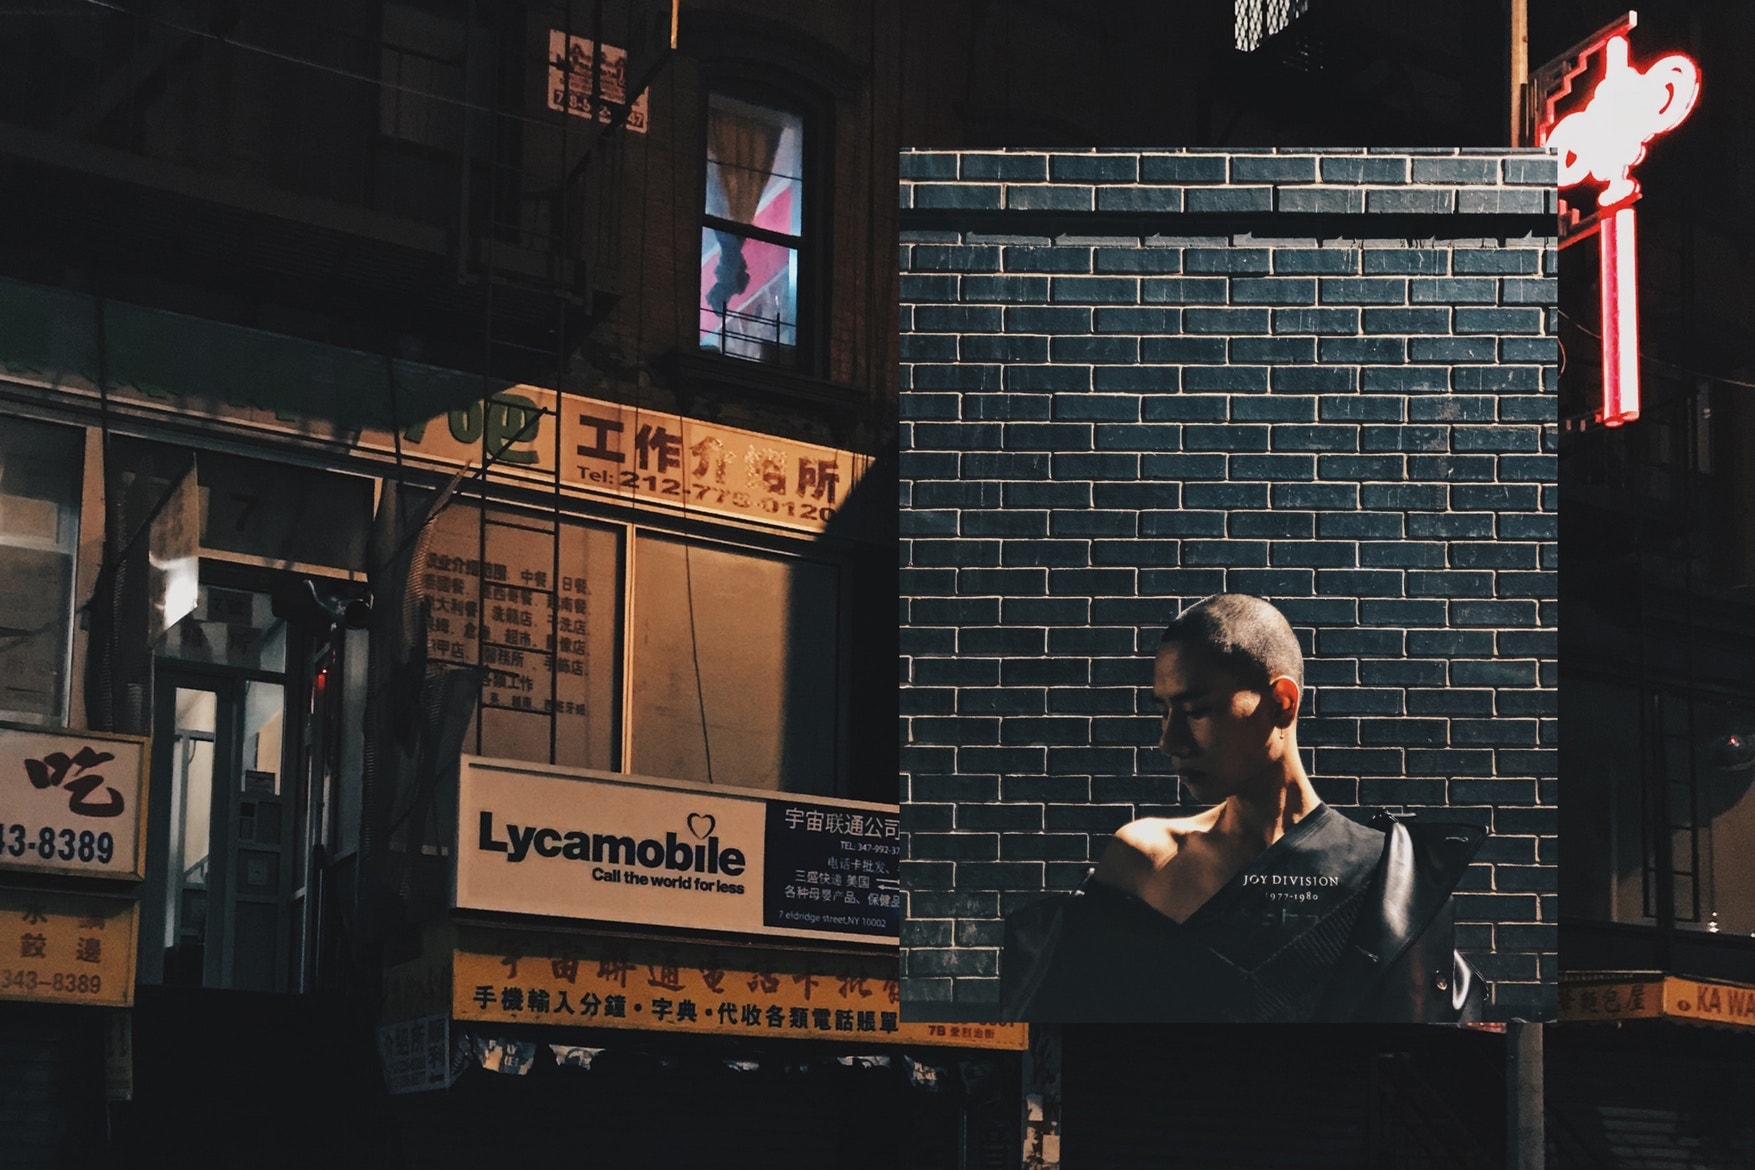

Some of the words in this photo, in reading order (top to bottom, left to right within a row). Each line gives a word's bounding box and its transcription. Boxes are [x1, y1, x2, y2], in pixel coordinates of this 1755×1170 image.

[576, 465, 614, 485] Tel:
[24, 745, 125, 818] 吃
[784, 807, 900, 841] 宇宙联通公司
[478, 810, 746, 877] Lycamobile
[592, 867, 621, 883] Call
[623, 871, 649, 886] the
[650, 874, 692, 890] world
[694, 877, 716, 892] for
[716, 879, 745, 895] less
[1242, 874, 1268, 887] JOY
[1272, 874, 1340, 888] DIVISION
[1265, 891, 1319, 903] 1977-1980
[785, 910, 821, 923] eldridge
[862, 917, 887, 928] 10002
[1697, 985, 1722, 1014] KA
[928, 1025, 947, 1037] 7B
